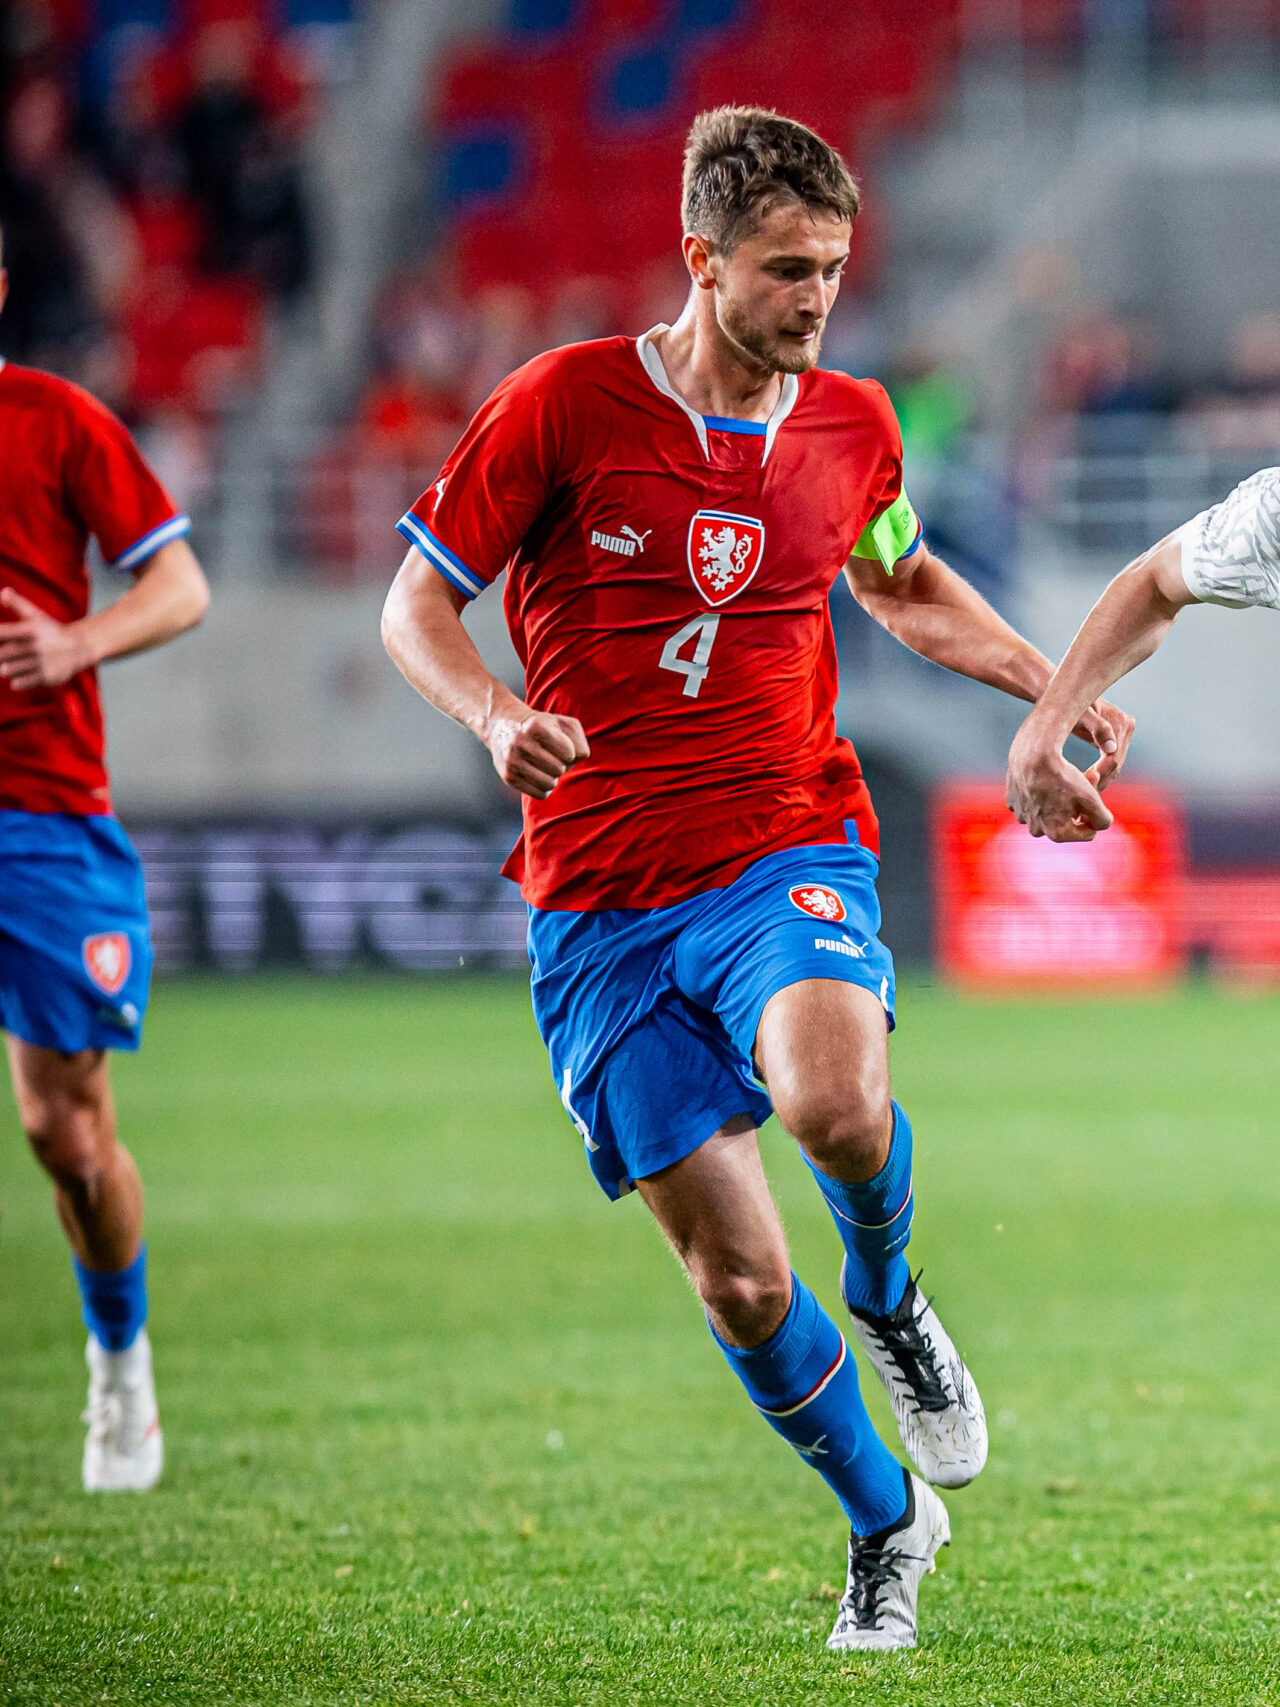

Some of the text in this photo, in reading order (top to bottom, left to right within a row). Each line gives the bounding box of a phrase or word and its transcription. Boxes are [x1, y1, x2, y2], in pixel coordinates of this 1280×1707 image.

[591, 530, 636, 557] PUMA
[658, 612, 721, 698] 4
[814, 938, 860, 959] PUMA
